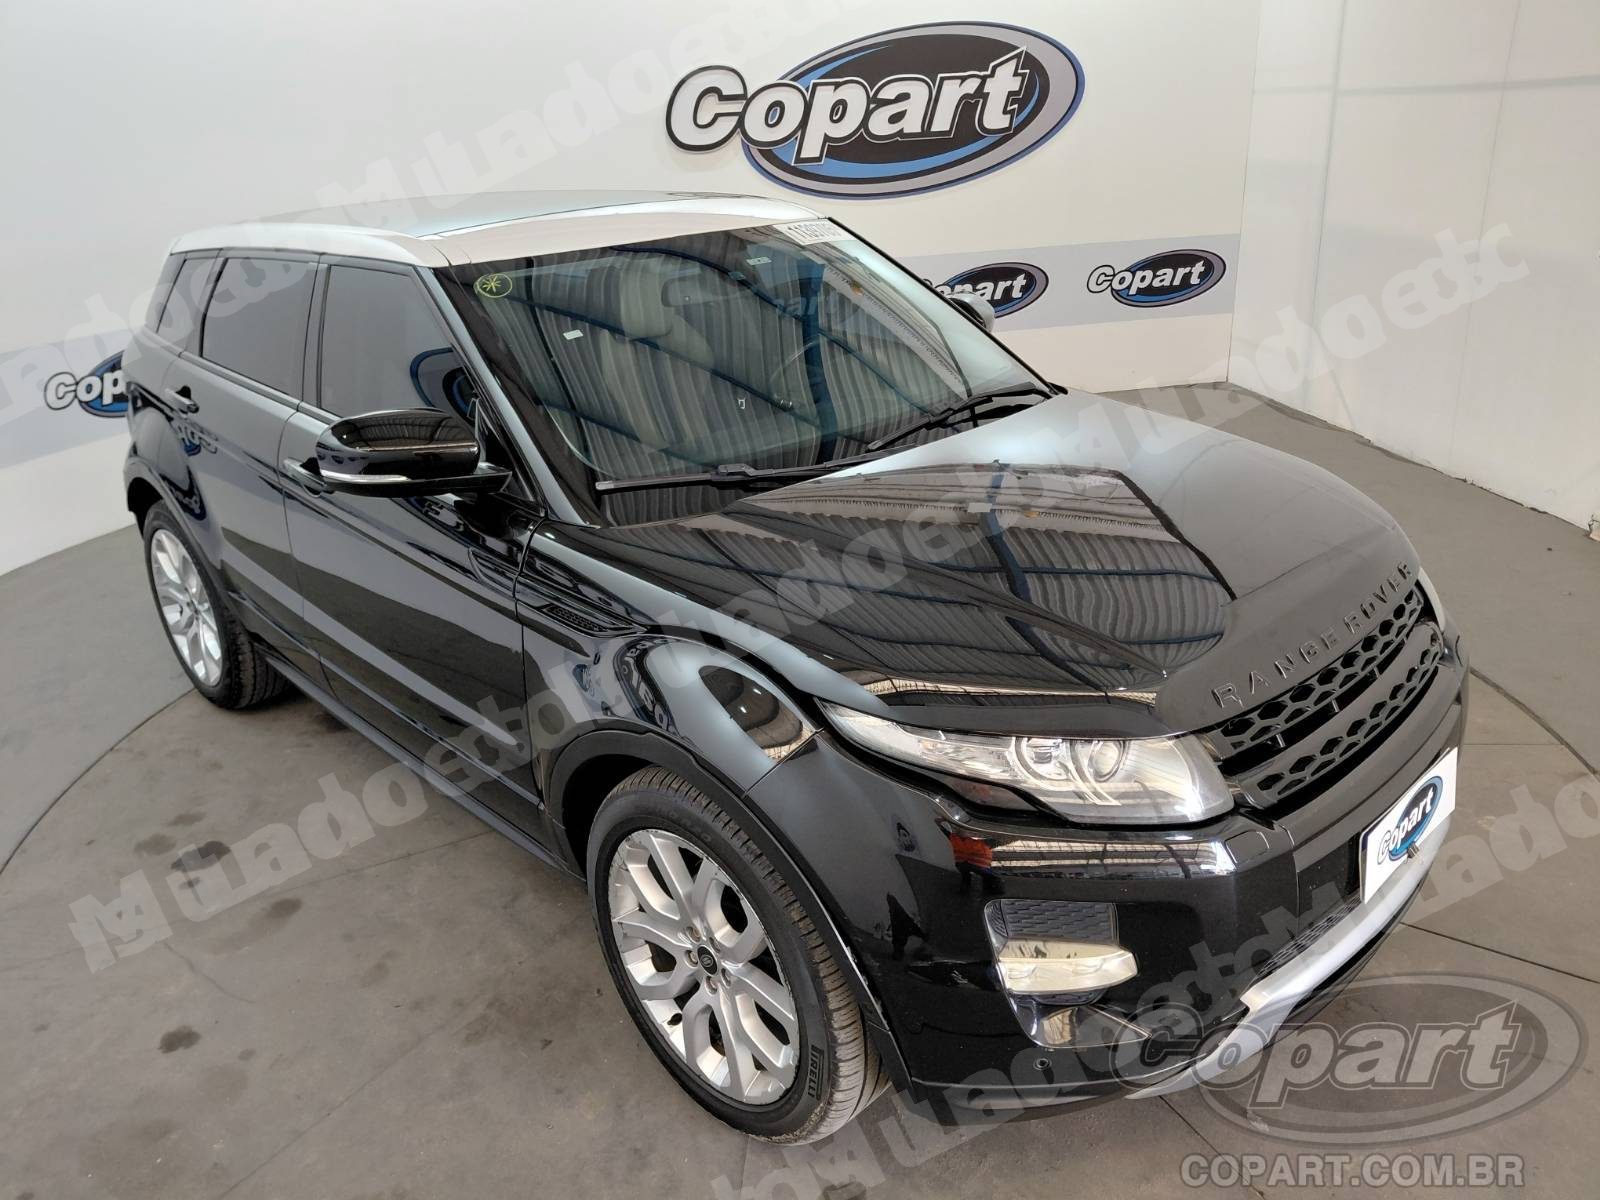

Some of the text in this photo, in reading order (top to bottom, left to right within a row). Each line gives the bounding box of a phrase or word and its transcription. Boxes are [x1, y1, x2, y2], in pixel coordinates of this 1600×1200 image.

[665, 46, 1029, 165] Copart
[922, 272, 1026, 301] oart
[1087, 260, 1205, 296] Copart
[1211, 561, 1412, 708] RANGE ROVER
[1377, 786, 1433, 865] Copart
[808, 1044, 825, 1100] PIRELLI
